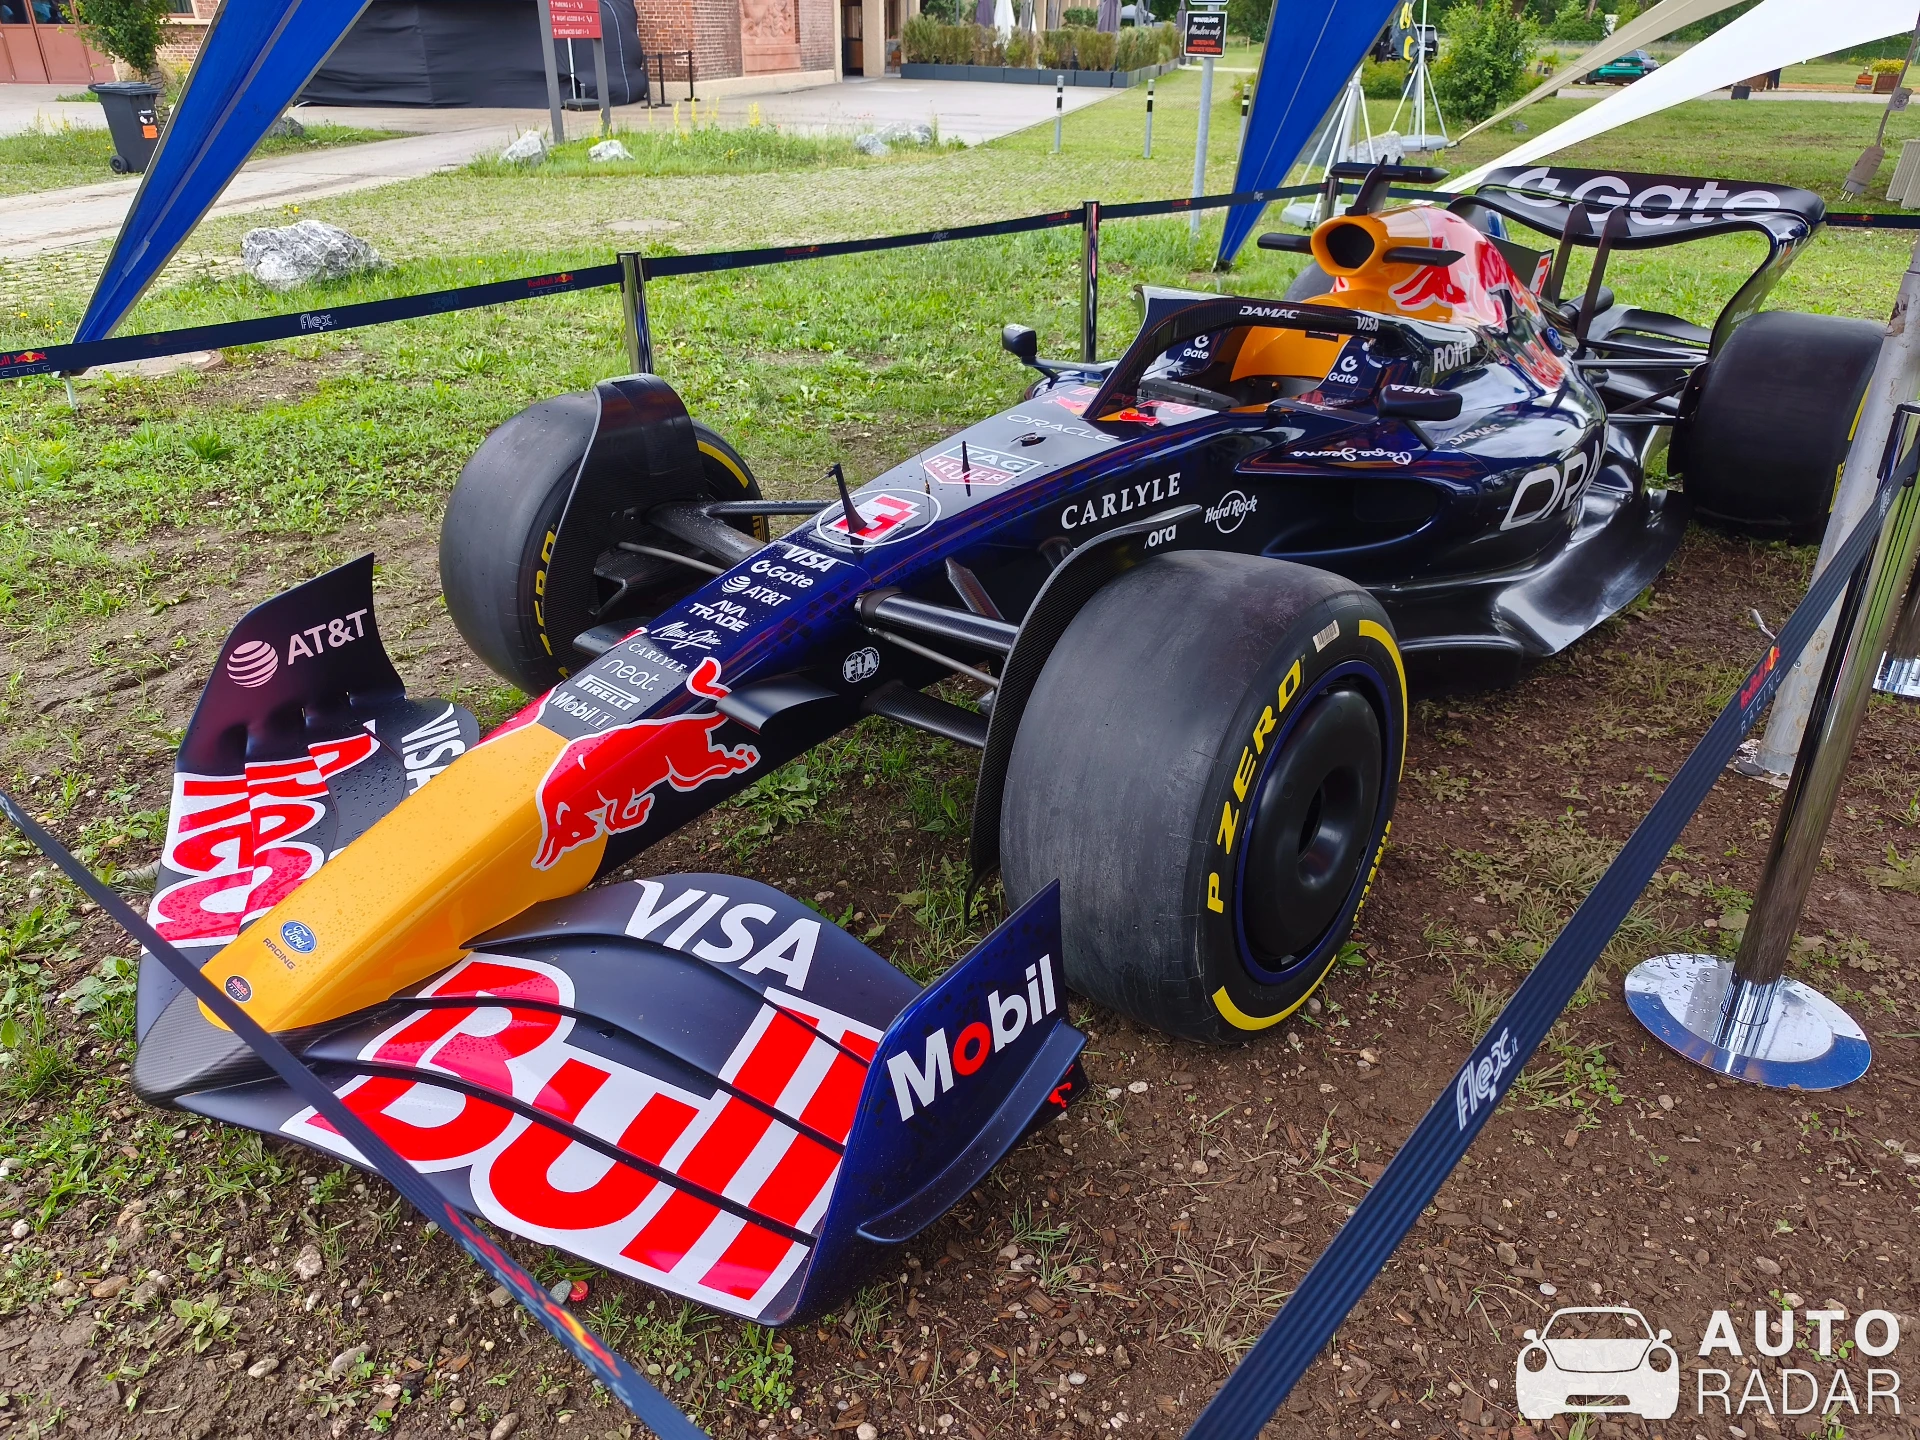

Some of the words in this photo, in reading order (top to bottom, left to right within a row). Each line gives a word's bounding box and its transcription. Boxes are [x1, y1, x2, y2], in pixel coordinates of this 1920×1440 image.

[1568, 175, 1781, 226] Gate
[1239, 305, 1300, 320] DAMAC
[1356, 316, 1380, 333] VISA
[1183, 348, 1210, 360] Gate
[1328, 371, 1359, 385] Gate
[1389, 384, 1440, 397] VISA
[1006, 414, 1120, 443] ORACLE
[1449, 423, 1507, 448] DAMAC
[930, 458, 1006, 482] HEUER
[960, 447, 1028, 472] TAG
[1357, 448, 1412, 466] Pepe
[1061, 472, 1181, 530] CARLYLE
[1204, 501, 1232, 523] Hard
[1231, 494, 1258, 517] Rock
[782, 545, 843, 573] VISA
[767, 564, 815, 589] Gate
[710, 599, 748, 619] AVA
[741, 583, 792, 608] AT&T
[688, 602, 750, 633] TRADE
[286, 607, 369, 667] AT&T
[628, 642, 688, 674] CARLYLE
[549, 691, 600, 722] Mobil
[574, 673, 642, 712] PIRELLI
[1739, 669, 1781, 734] RACING
[1207, 872, 1225, 914] P
[1216, 658, 1301, 856] ZERO
[284, 925, 312, 950] Ford
[623, 879, 821, 992] VISA
[262, 937, 297, 971] RACING
[885, 953, 1057, 1122] Mobil
[290, 953, 882, 1312] Bull
